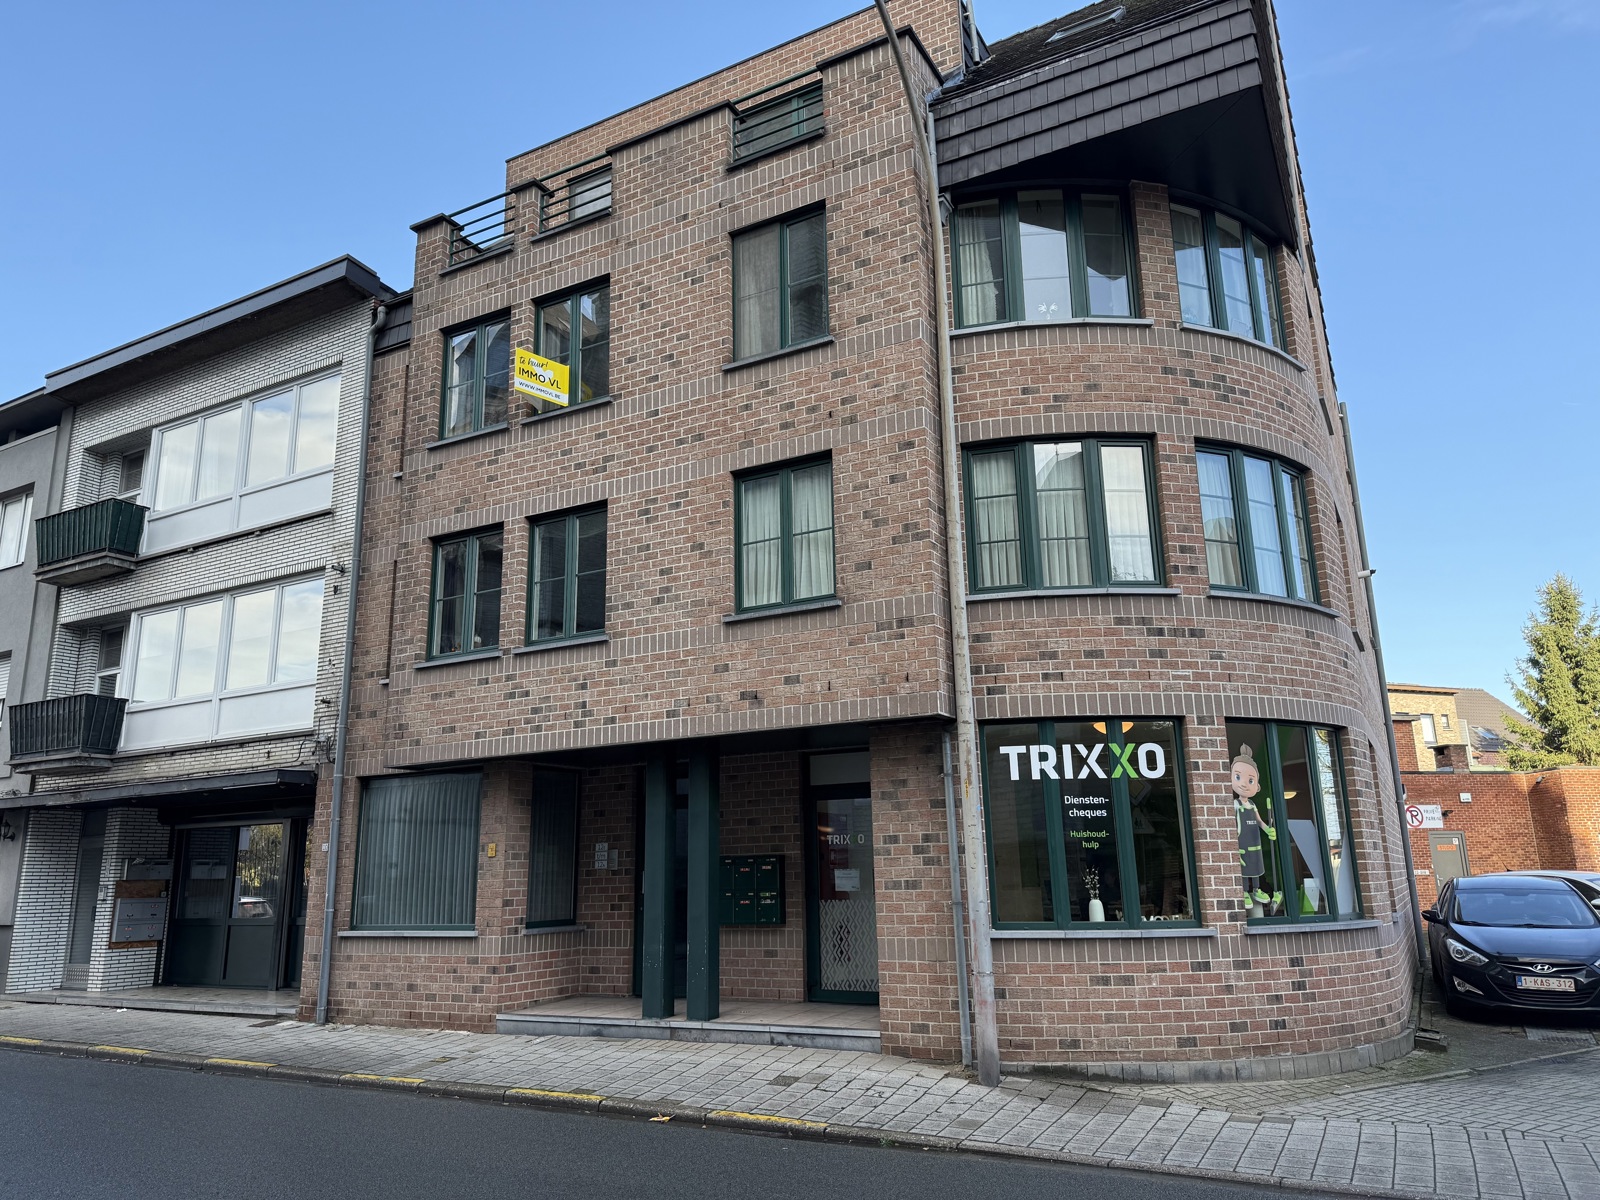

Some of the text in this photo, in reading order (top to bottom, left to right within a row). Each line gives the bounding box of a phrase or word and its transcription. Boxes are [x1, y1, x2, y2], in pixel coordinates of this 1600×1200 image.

[518, 367, 561, 389] IMMO VL
[999, 742, 1166, 780] TRIXXO
[1064, 795, 1109, 804] Diensten-
[1068, 809, 1107, 819] cheques
[1070, 830, 1109, 838] Huishoud-
[1082, 839, 1099, 849] hulp
